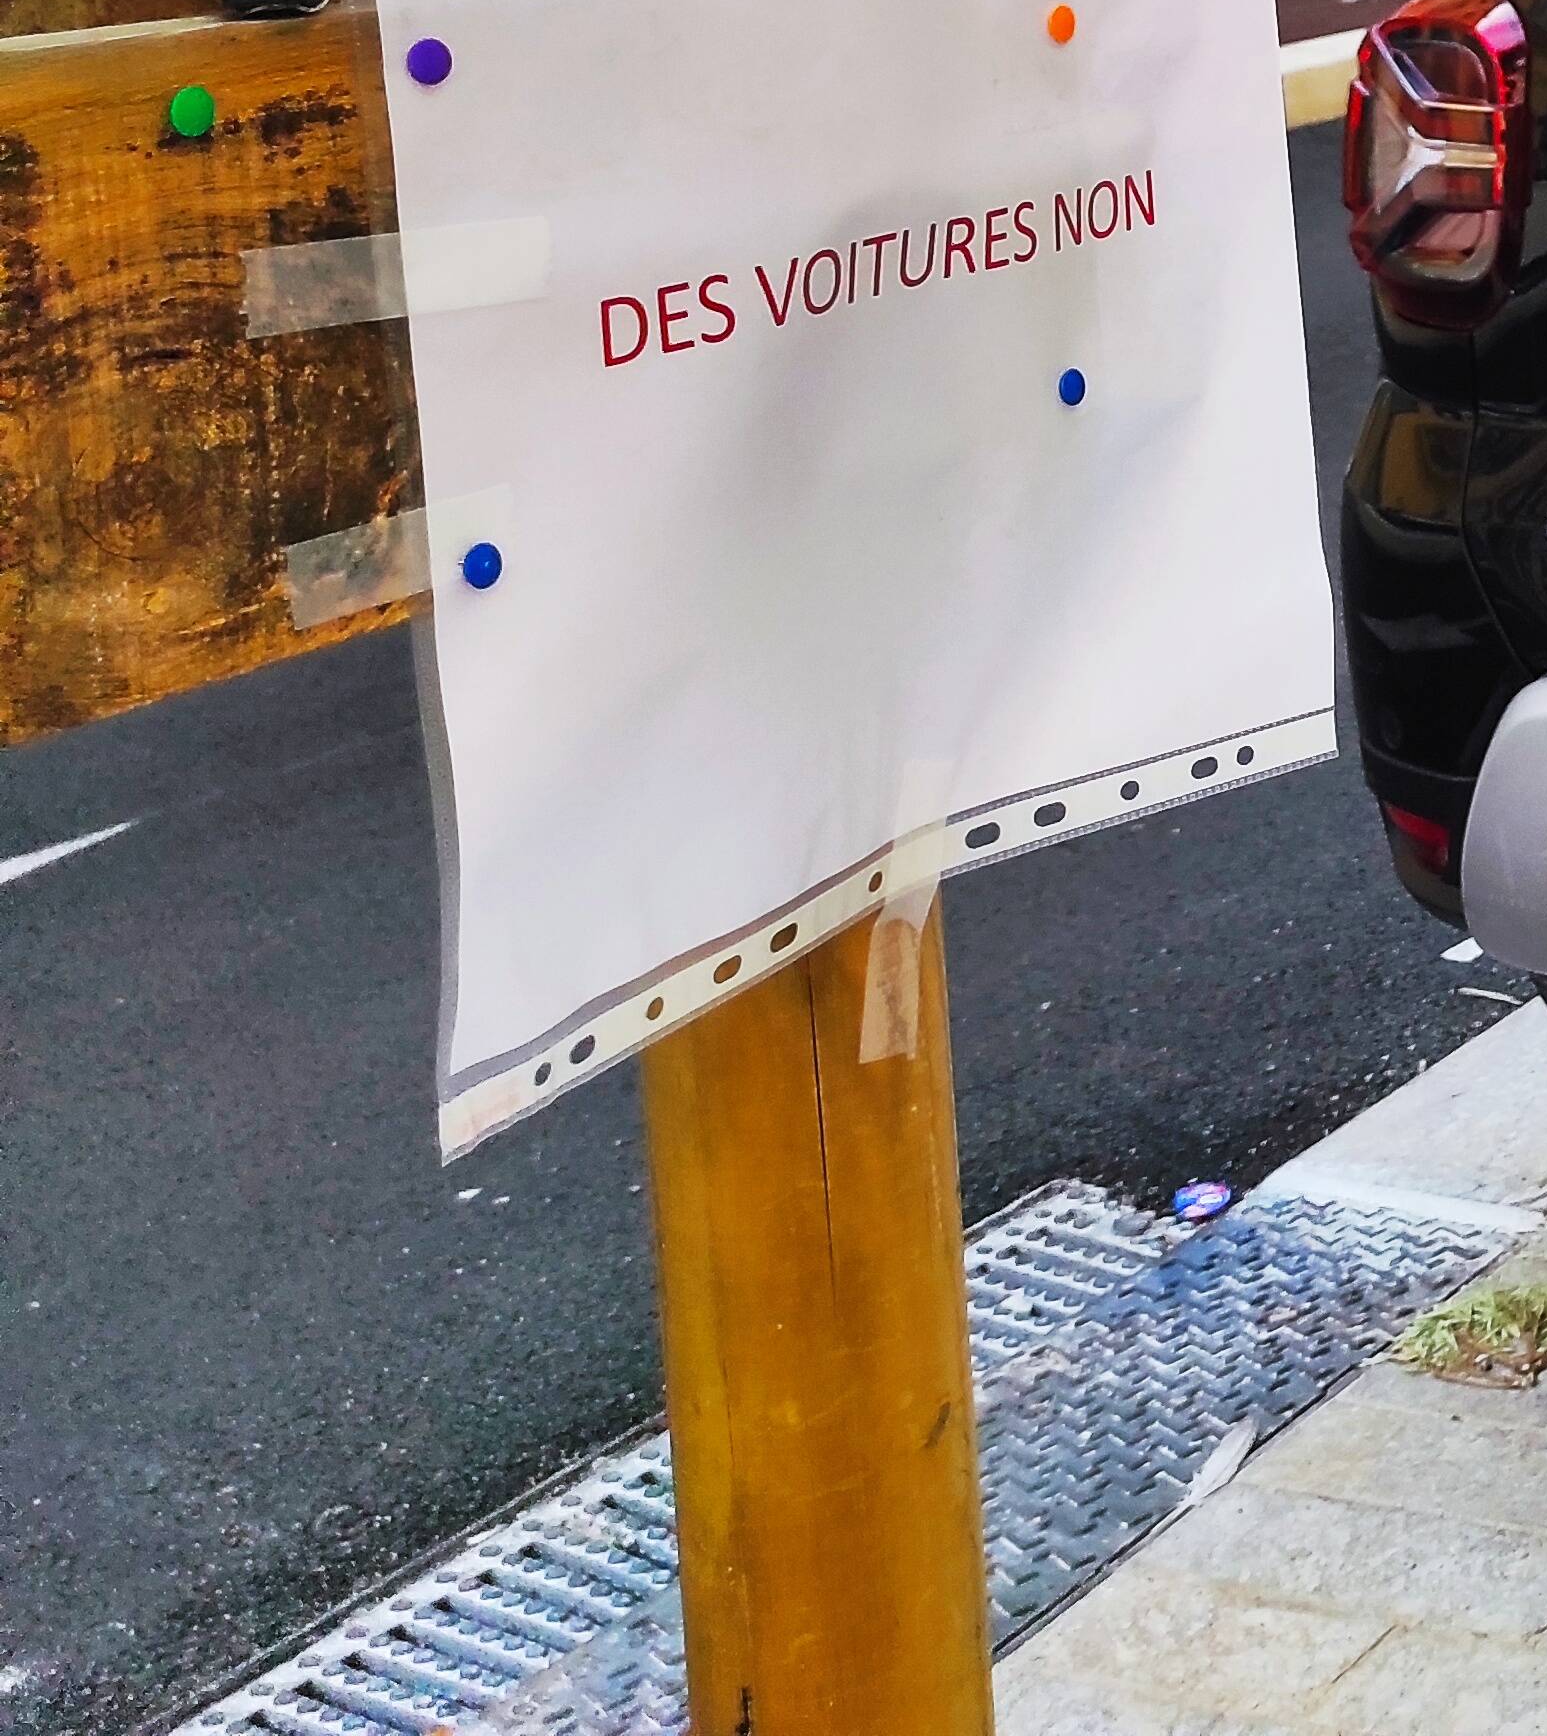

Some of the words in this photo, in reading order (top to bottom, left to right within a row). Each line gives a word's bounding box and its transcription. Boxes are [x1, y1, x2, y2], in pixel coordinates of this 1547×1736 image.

[600, 274, 736, 367] DES
[755, 201, 1037, 326] VOITURES
[1054, 170, 1156, 252] NON
